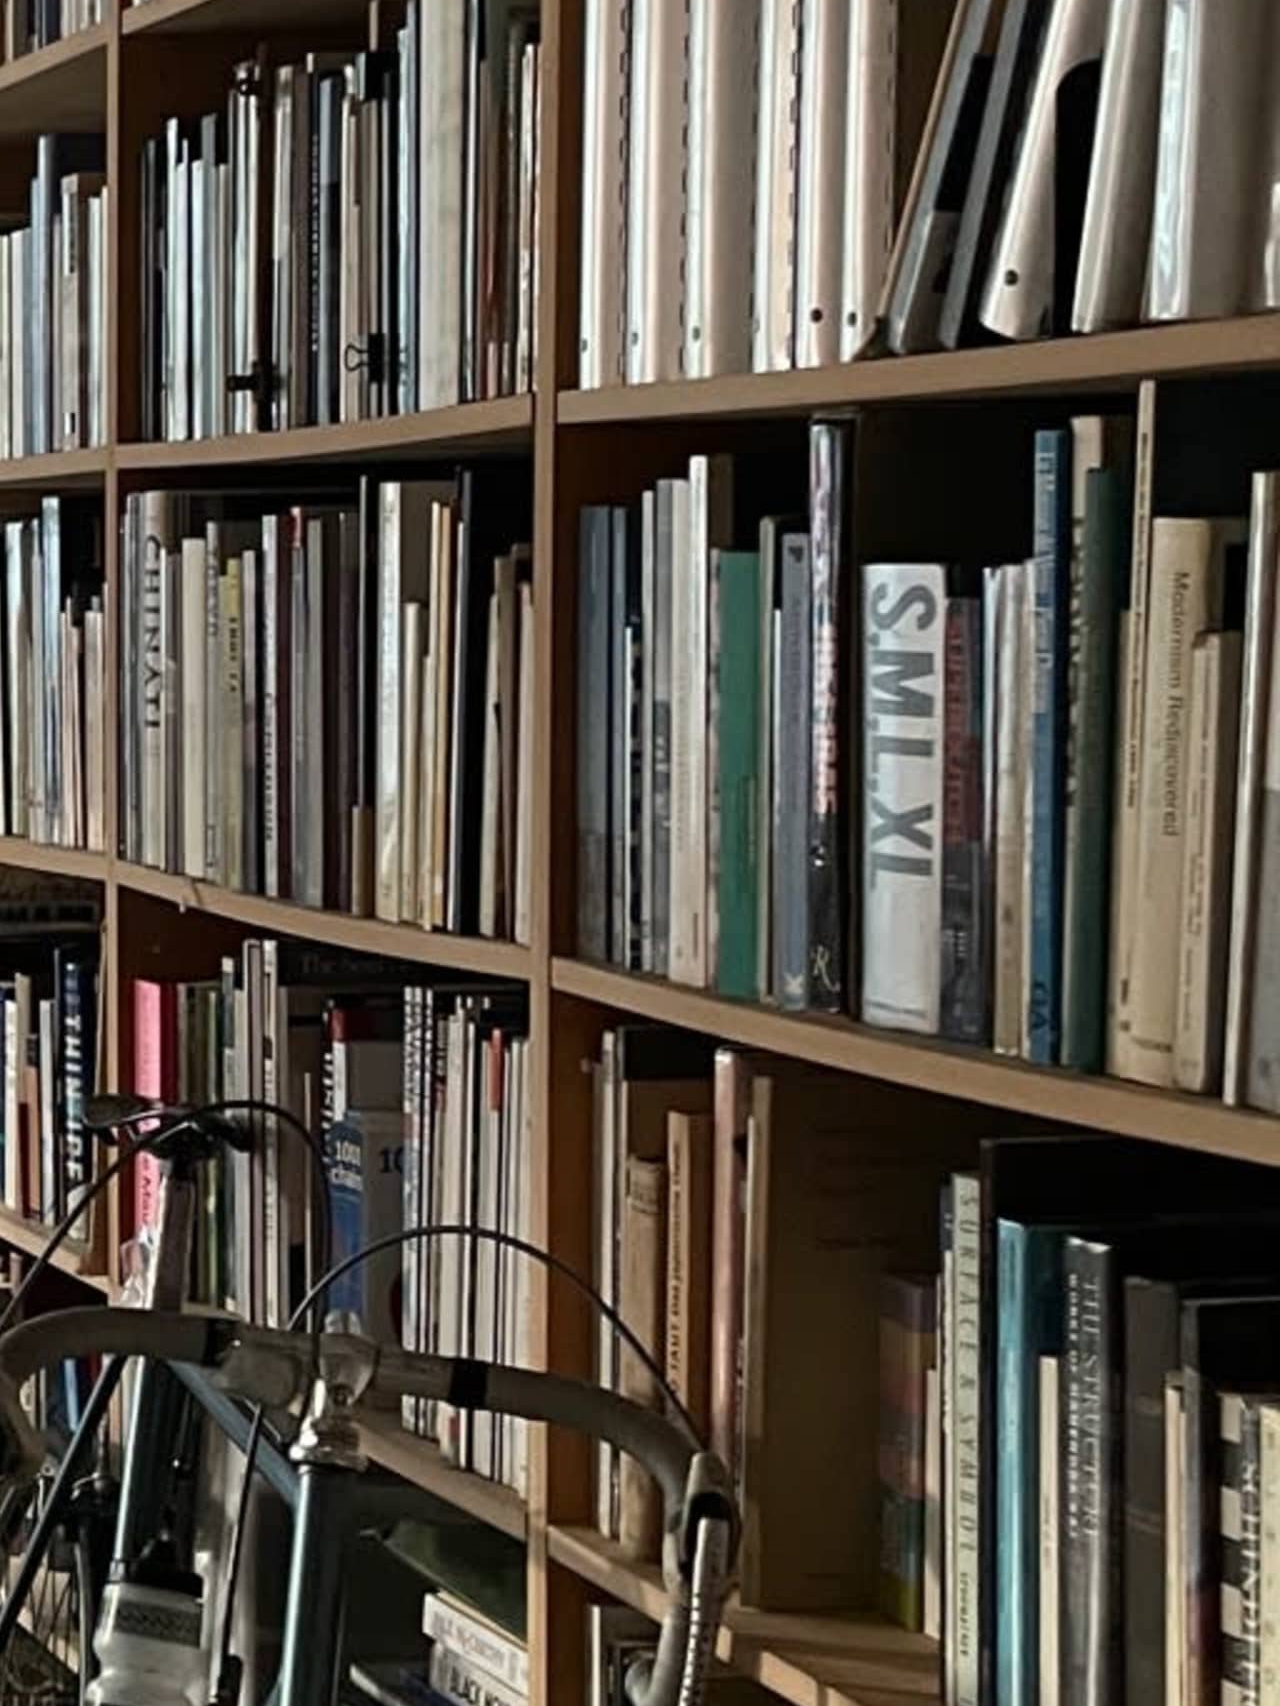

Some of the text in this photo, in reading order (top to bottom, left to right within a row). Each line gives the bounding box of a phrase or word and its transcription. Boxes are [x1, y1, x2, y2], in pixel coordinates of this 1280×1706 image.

[144, 533, 162, 730] CHINATI
[1162, 569, 1193, 837] Modernism Rediscovered
[958, 1185, 979, 1353] SURFACE
[956, 1410, 976, 1555] SYMBOL
[1082, 1277, 1101, 1537] THE STRUCTURE
